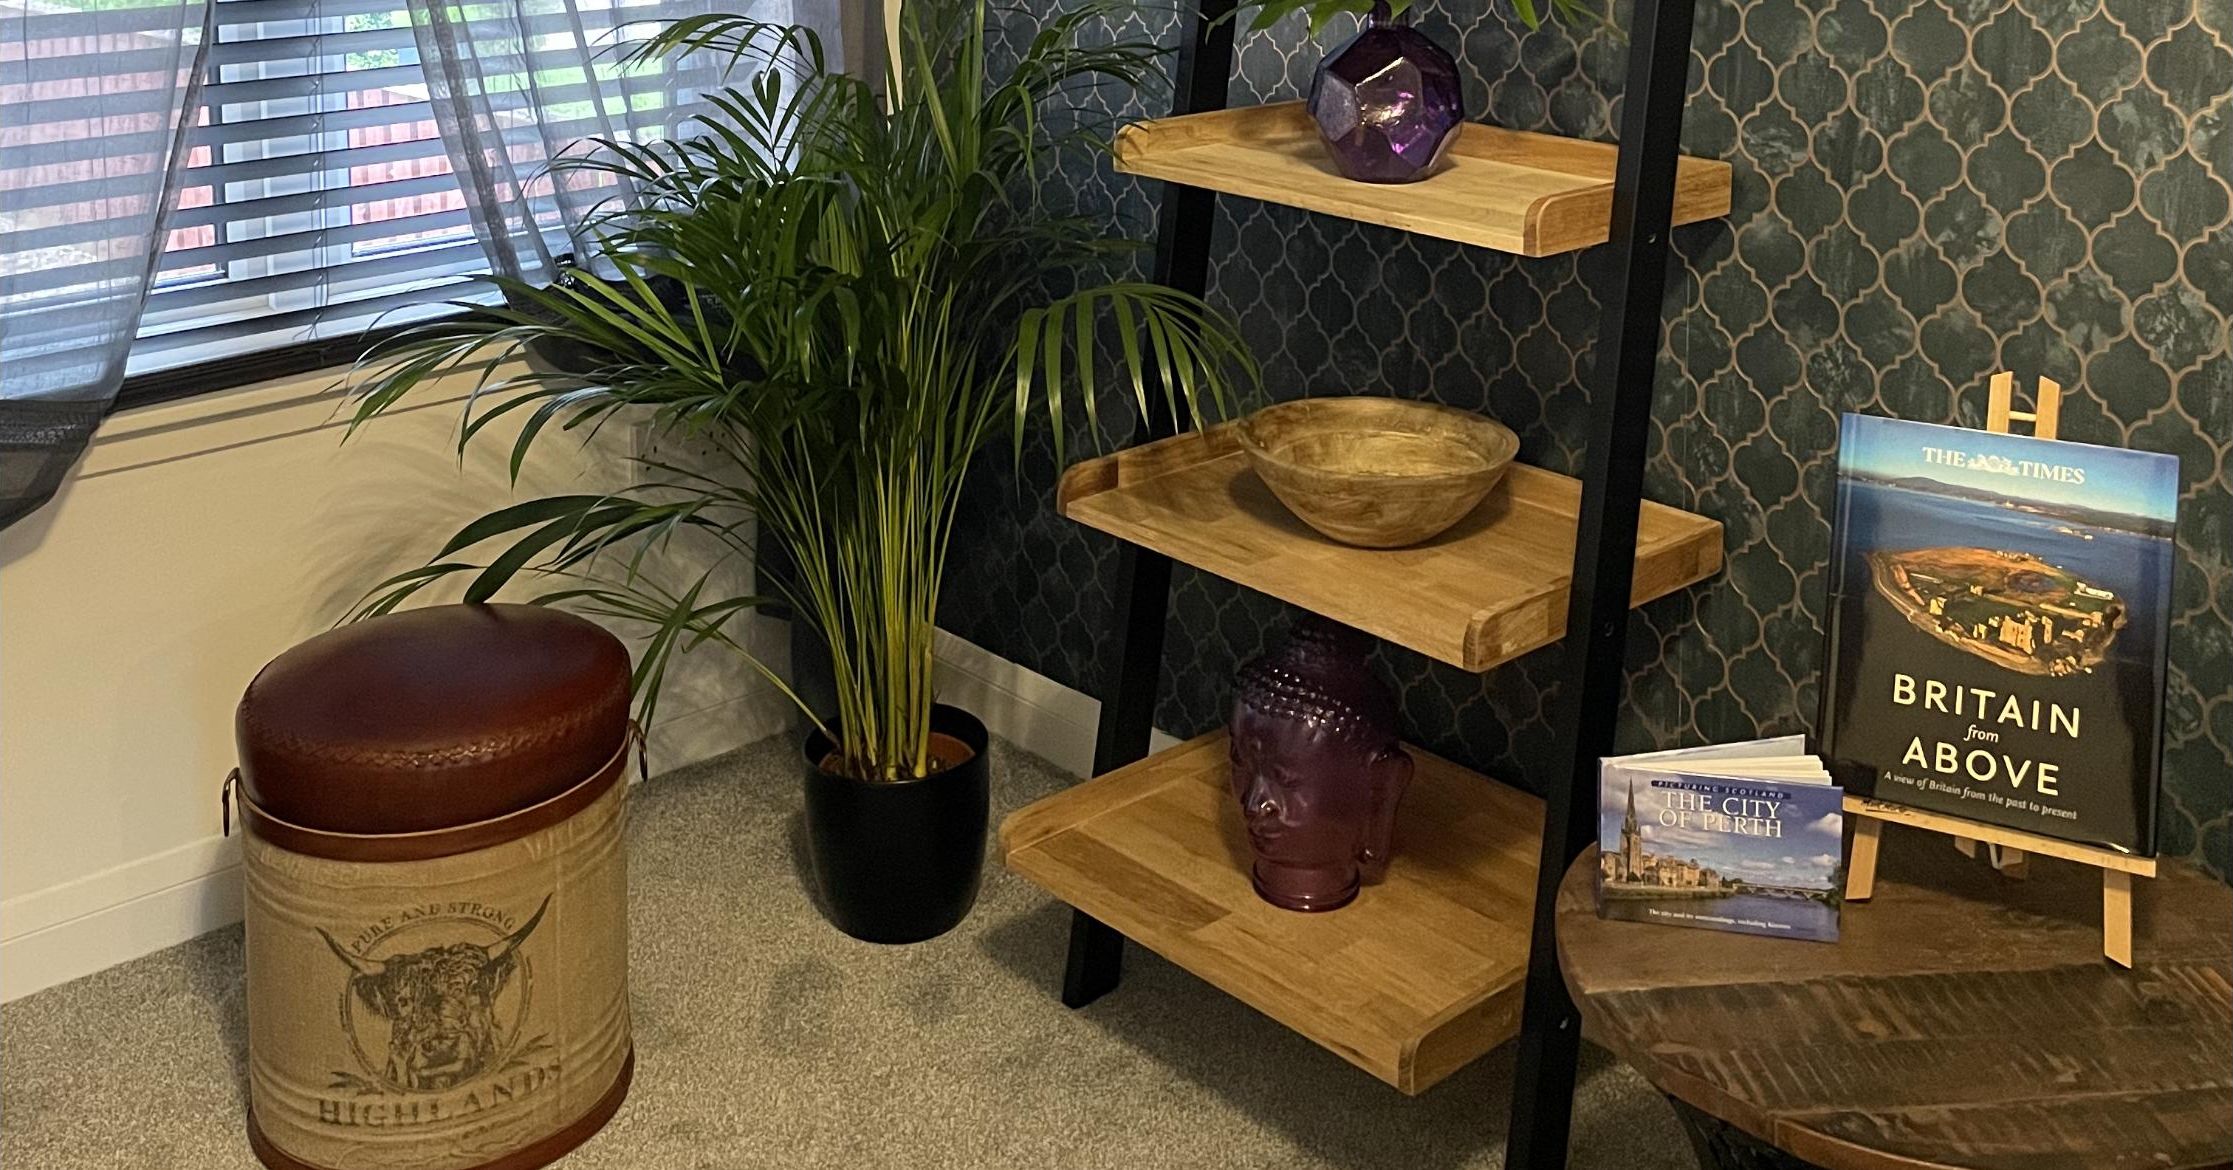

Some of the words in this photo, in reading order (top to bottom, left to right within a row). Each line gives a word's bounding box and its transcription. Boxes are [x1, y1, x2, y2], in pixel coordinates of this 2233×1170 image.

[1922, 446, 1967, 468] THE
[2018, 460, 2086, 485] TIMES
[1893, 673, 2080, 739] BRITAIN
[1963, 724, 1999, 743] from
[1902, 736, 2059, 796] ABOVE
[1657, 781, 1719, 793] PICTURING
[1724, 787, 1784, 799] SCOTLAND
[1661, 791, 1713, 812] THE
[1722, 797, 1781, 819] CITY
[1884, 771, 1892, 780] A
[1893, 774, 1914, 786] view
[1916, 777, 1929, 790] of
[1929, 780, 1961, 796] Britain
[1961, 786, 1986, 801] from
[1988, 792, 2004, 806] the
[2006, 796, 2027, 810] past
[2029, 802, 2040, 812] to
[2041, 804, 2078, 820] present
[1659, 808, 1693, 828] OF
[1702, 811, 1782, 838] PERTH
[351, 916, 394, 954] PURE
[400, 902, 441, 923] AND
[447, 901, 516, 931] STRONG
